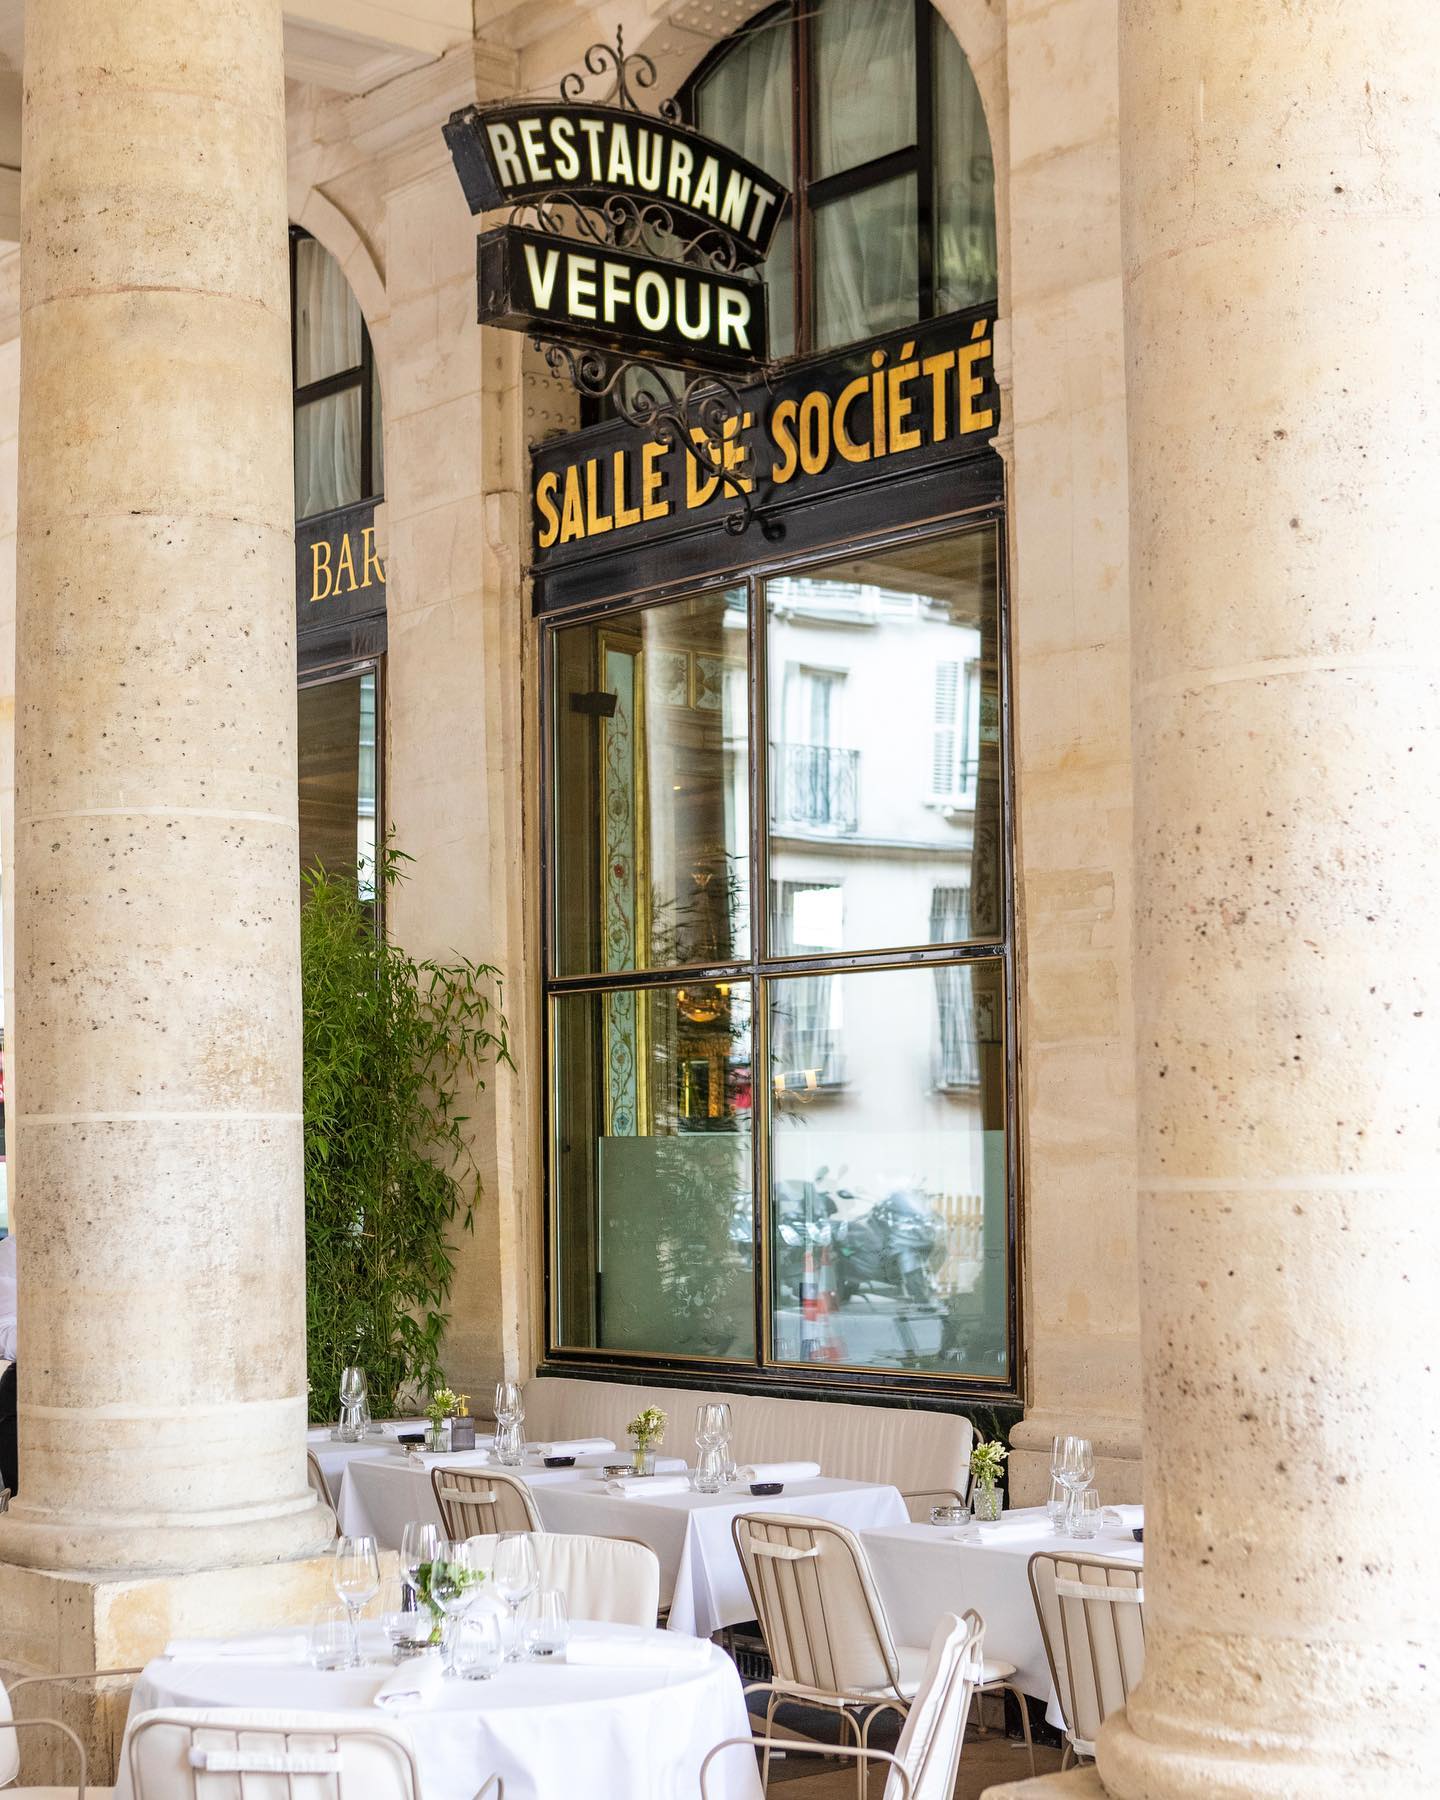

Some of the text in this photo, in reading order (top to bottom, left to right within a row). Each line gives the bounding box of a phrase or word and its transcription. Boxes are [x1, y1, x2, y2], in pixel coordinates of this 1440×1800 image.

[487, 117, 776, 242] RESTAURANT
[523, 244, 752, 350] VEFOUR
[538, 318, 994, 548] SALLE DE SOCIÉTÉ
[310, 527, 386, 602] BAR
